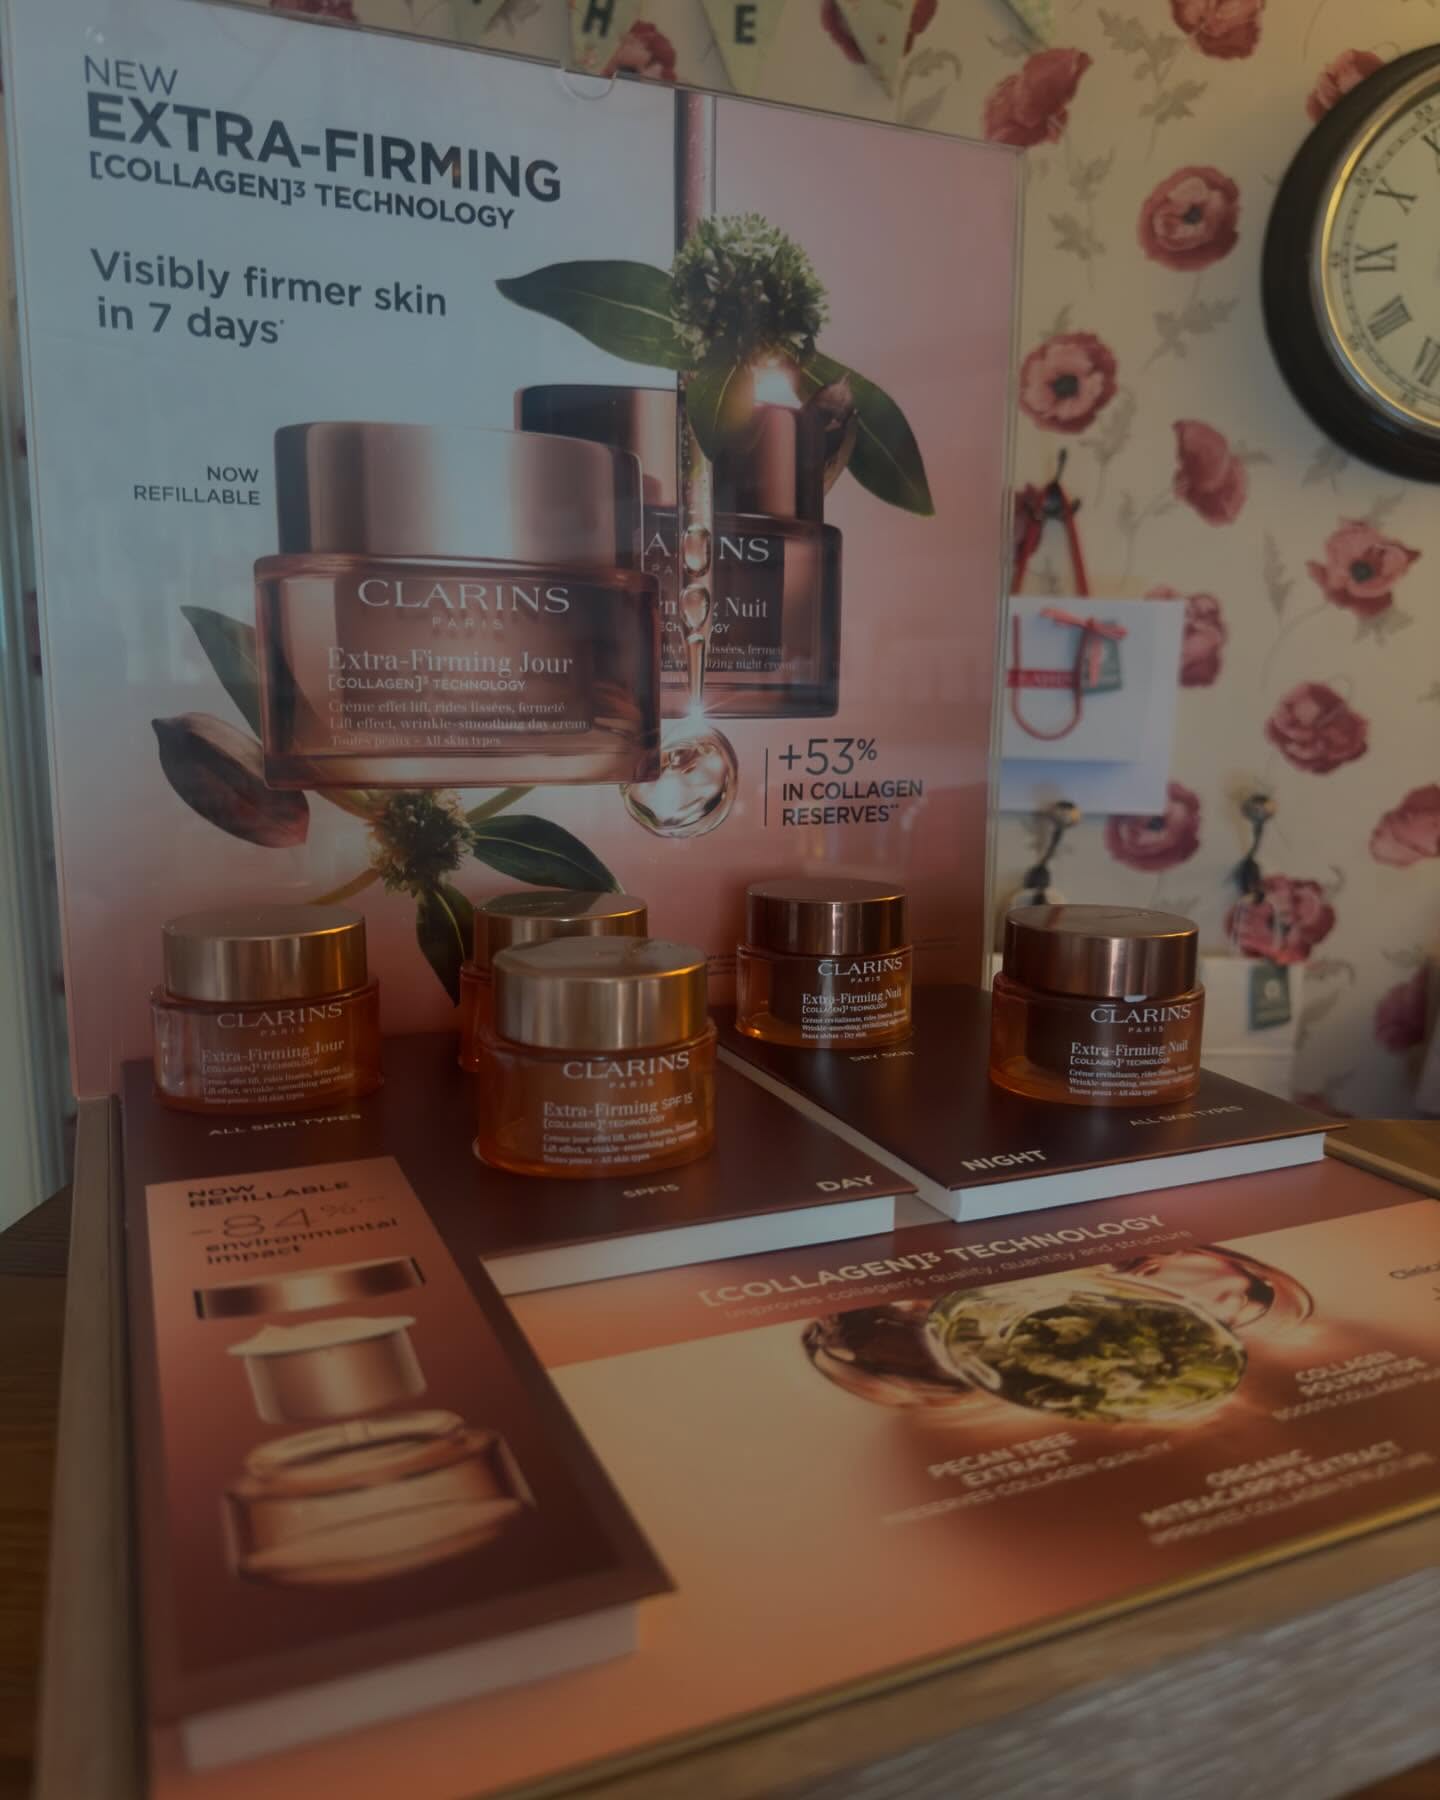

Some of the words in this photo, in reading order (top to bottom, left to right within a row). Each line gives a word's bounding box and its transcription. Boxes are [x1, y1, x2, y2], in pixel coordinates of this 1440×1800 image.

[735, 5, 756, 44] E
[84, 56, 178, 95] NEW
[87, 92, 561, 202] EXTRA-FIRMING
[314, 184, 515, 229] TECHNOLOGY
[90, 248, 229, 297] Visibly
[244, 267, 361, 308] firmer
[375, 282, 447, 315] skin
[98, 297, 133, 330] in
[149, 303, 171, 332] 7
[207, 465, 259, 483] NOW
[134, 485, 261, 506] REFILLABLE
[358, 579, 570, 614] CLARINS
[725, 597, 768, 618] Nuit
[432, 617, 504, 630] PARIS
[327, 647, 512, 677] Extra-Firming
[519, 651, 574, 675] Jour
[433, 678, 527, 692] TECHNOLOGY
[779, 738, 877, 775] +53%
[783, 783, 803, 801] IN
[810, 780, 923, 800] COLLAGEN
[817, 957, 903, 976] CLARINS
[802, 992, 883, 1005] Extra-Firming
[217, 1003, 344, 1029] CLARINS
[1090, 1004, 1192, 1024] CLARINS
[260, 1026, 305, 1037] PARIS
[202, 1046, 310, 1064] Extra-Firming
[314, 1039, 345, 1055] Jour
[1071, 1041, 1167, 1058] Extra-Firming
[563, 1051, 690, 1079] CLARINS
[609, 1079, 655, 1089] PARIS
[543, 1100, 659, 1118] Extra-Firming
[662, 1096, 682, 1111] SPF
[683, 1092, 693, 1105] 15
[960, 1149, 1049, 1173] NIGHT
[188, 1184, 255, 1198] NOW
[189, 1181, 349, 1208] REFILLABLE
[815, 1174, 875, 1194] DAY
[205, 1217, 399, 1252] environmental
[944, 1214, 1166, 1262] TECHNOLOGY
[207, 1245, 300, 1265] impact
[1000, 1250, 1076, 1272] quantity
[1080, 1242, 1113, 1258] and
[1115, 1230, 1193, 1250] structure
